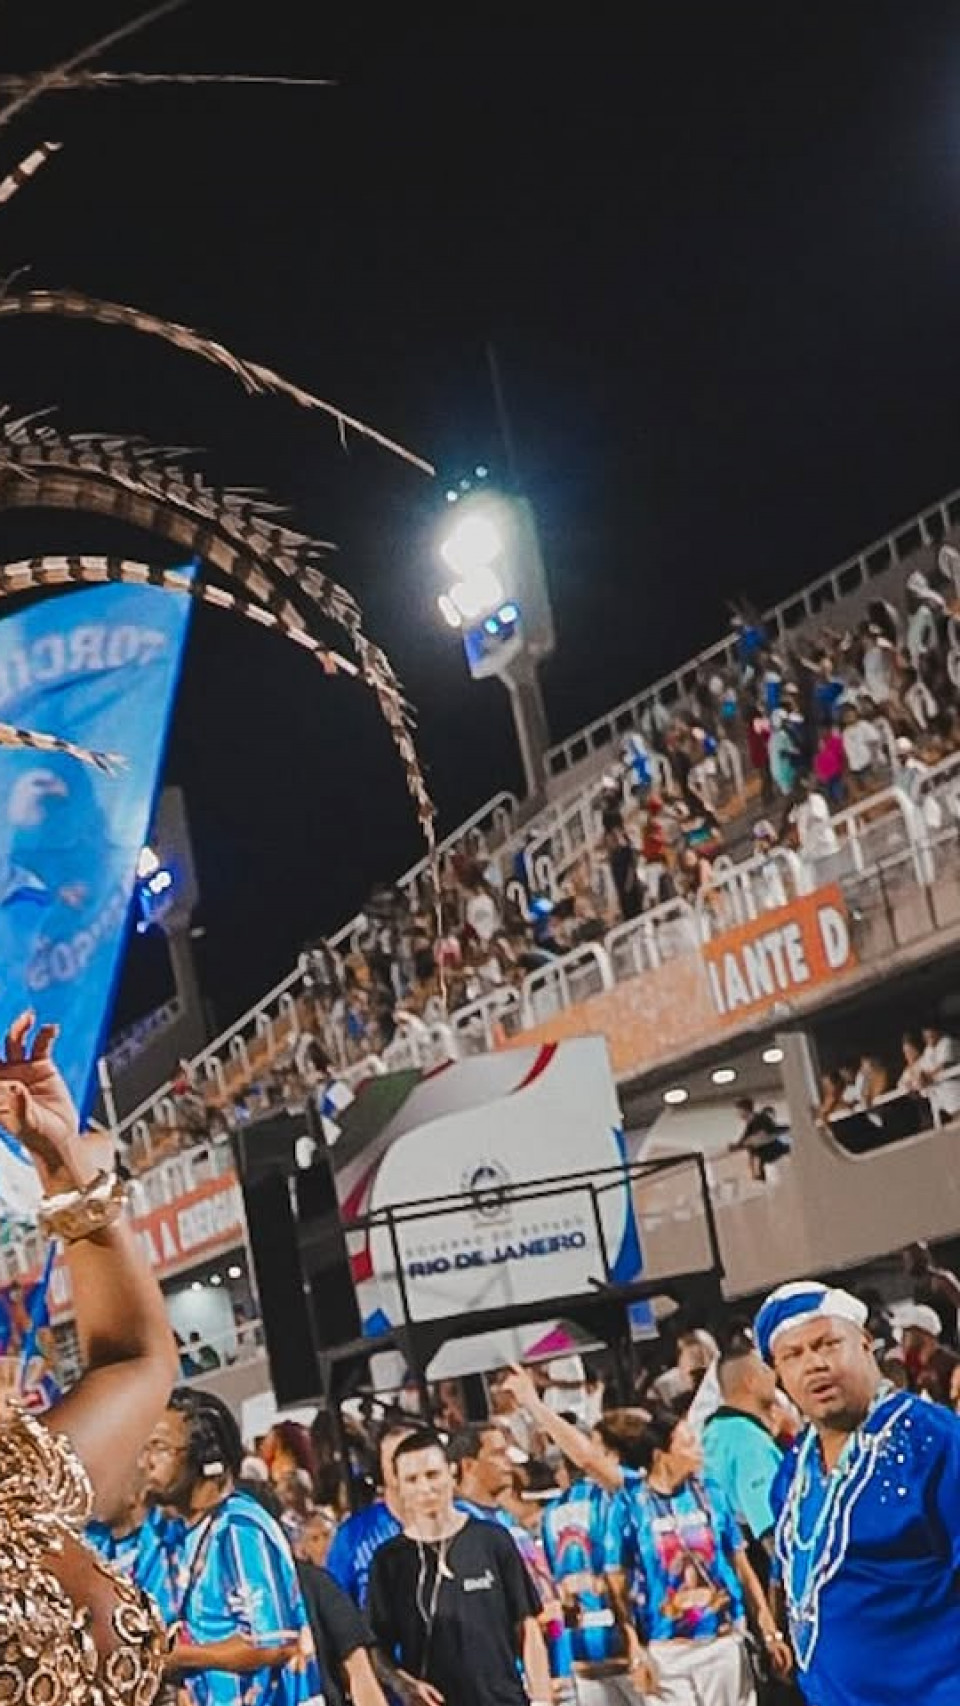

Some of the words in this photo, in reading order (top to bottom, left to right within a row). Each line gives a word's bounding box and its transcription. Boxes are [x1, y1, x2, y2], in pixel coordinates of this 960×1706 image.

[817, 906, 849, 968] D
[408, 1257, 451, 1279] RIO
[455, 1250, 486, 1270] DE
[490, 1231, 586, 1264] JANEIRO
